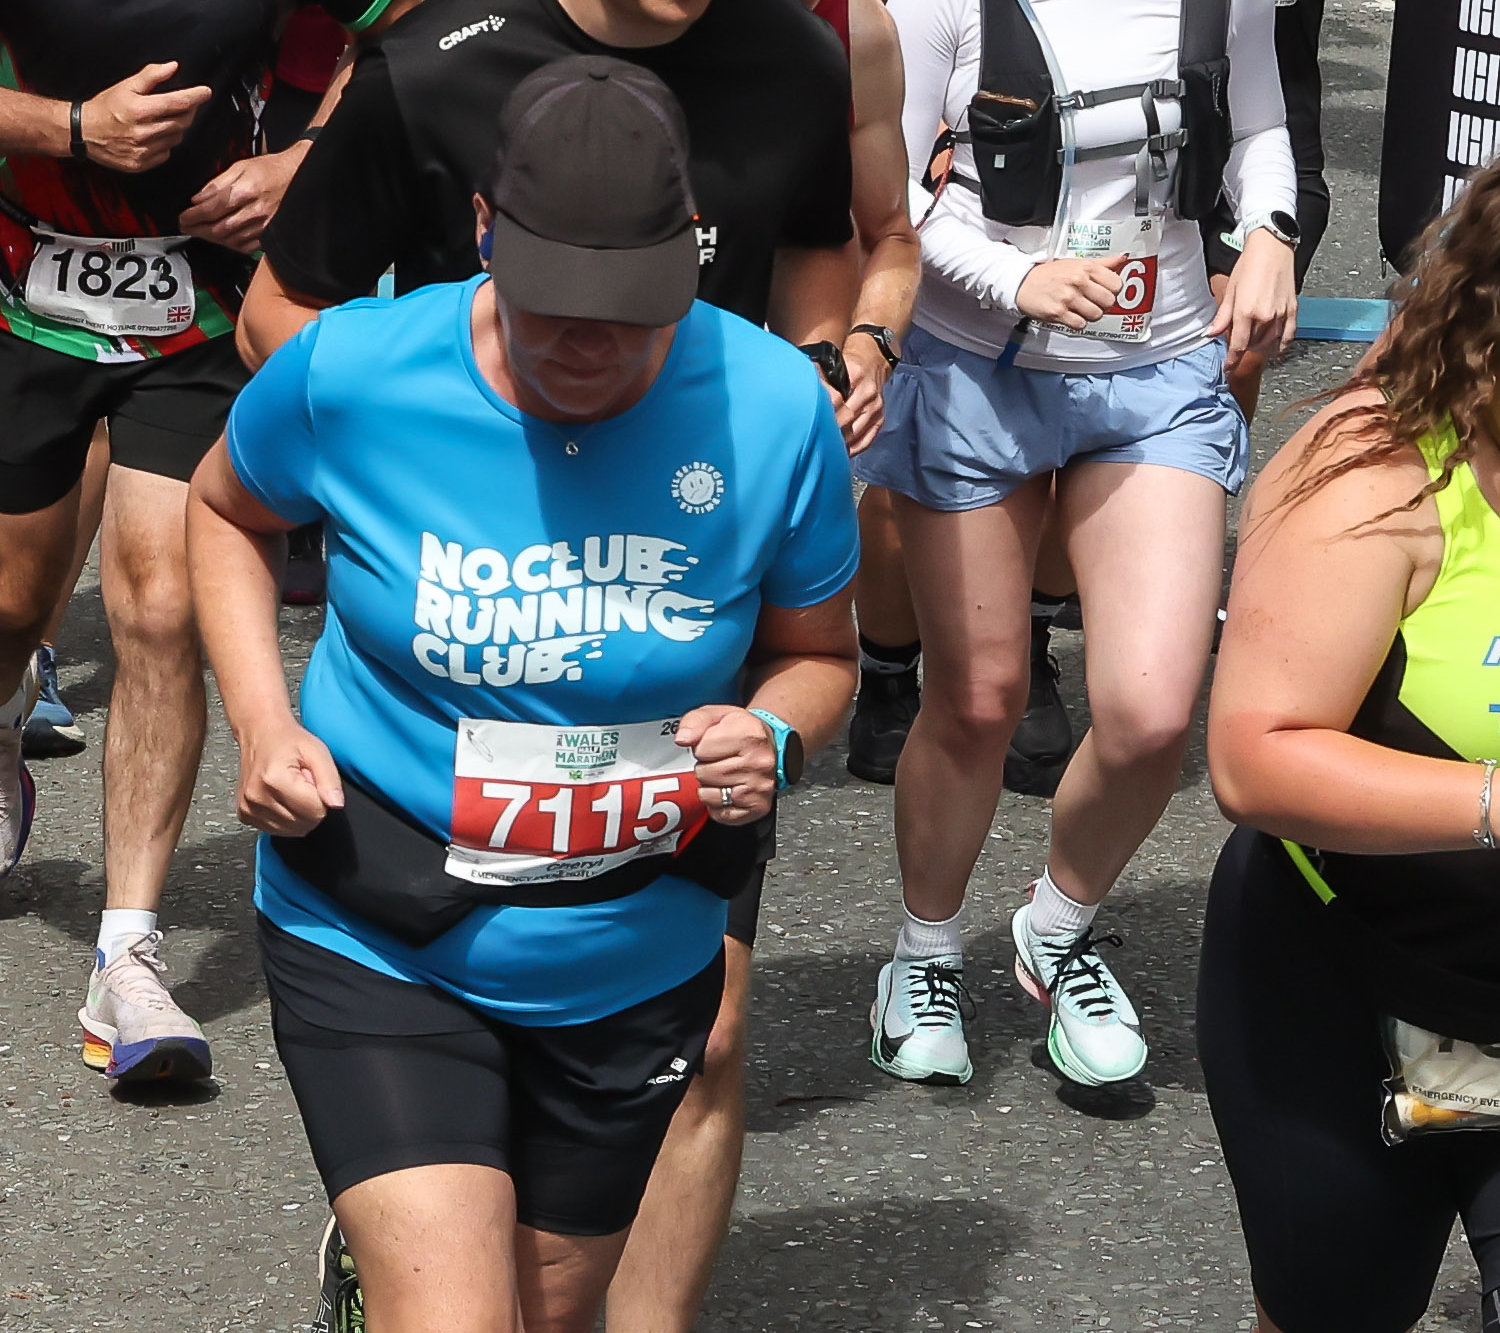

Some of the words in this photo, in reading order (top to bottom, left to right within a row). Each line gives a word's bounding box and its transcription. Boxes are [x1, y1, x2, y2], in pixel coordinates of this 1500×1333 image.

[438, 20, 489, 51] CRAFT
[1140, 220, 1153, 233] 26
[52, 248, 179, 301] 1823
[414, 579, 715, 640] RUNNING
[563, 731, 620, 750] WALES
[555, 750, 617, 765] MARATHON
[480, 777, 683, 853] 7115
[1411, 1085, 1477, 1105] EMERGENCY
